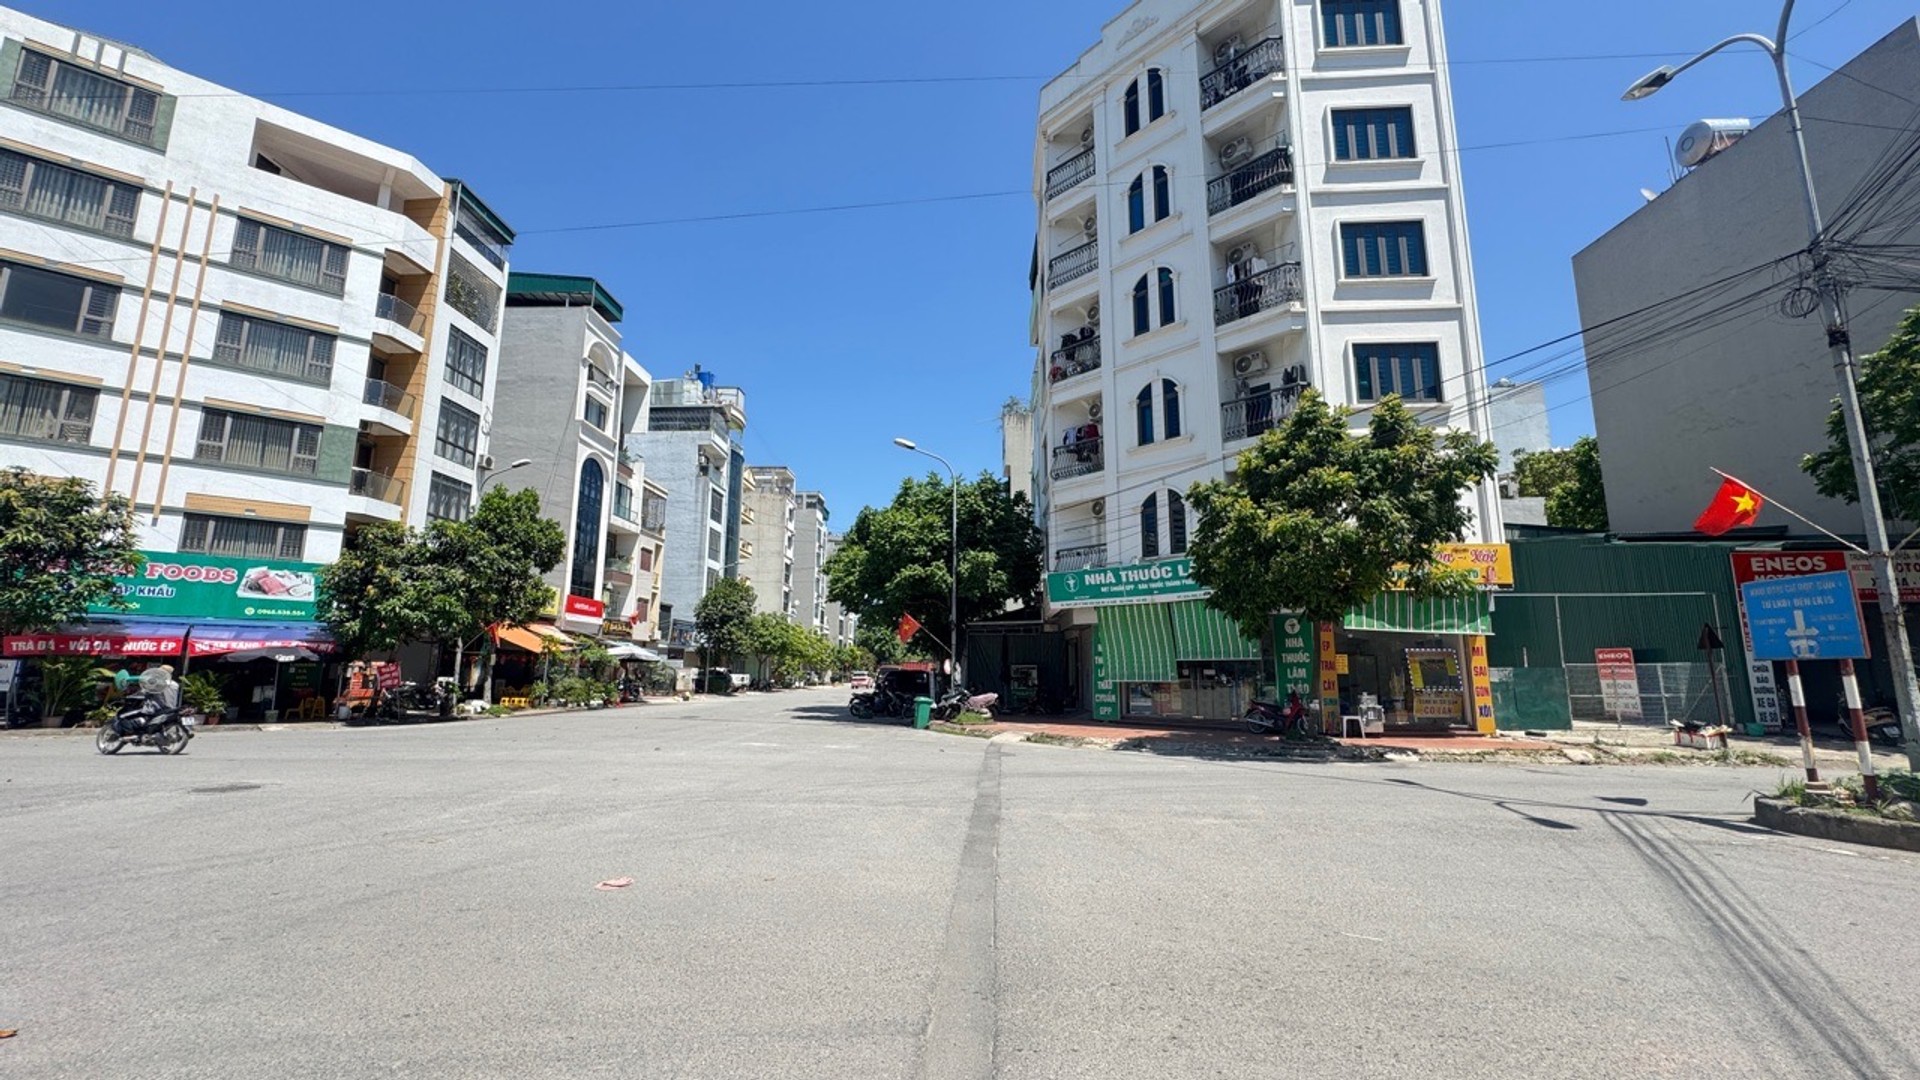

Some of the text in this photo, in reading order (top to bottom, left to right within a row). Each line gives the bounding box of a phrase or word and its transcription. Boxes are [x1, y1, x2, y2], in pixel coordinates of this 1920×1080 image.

[1750, 556, 1827, 572] ENEOS
[145, 562, 239, 584] FOODS
[1084, 570, 1116, 586] NHÀ
[1119, 561, 1173, 583] THUỐC
[137, 583, 176, 598] KHẨU
[11, 640, 34, 651] TRÀ
[160, 640, 177, 651] ÉP
[1285, 635, 1304, 648] NHÀ
[1281, 650, 1311, 664] THUỐC
[1287, 665, 1307, 679] LÂM
